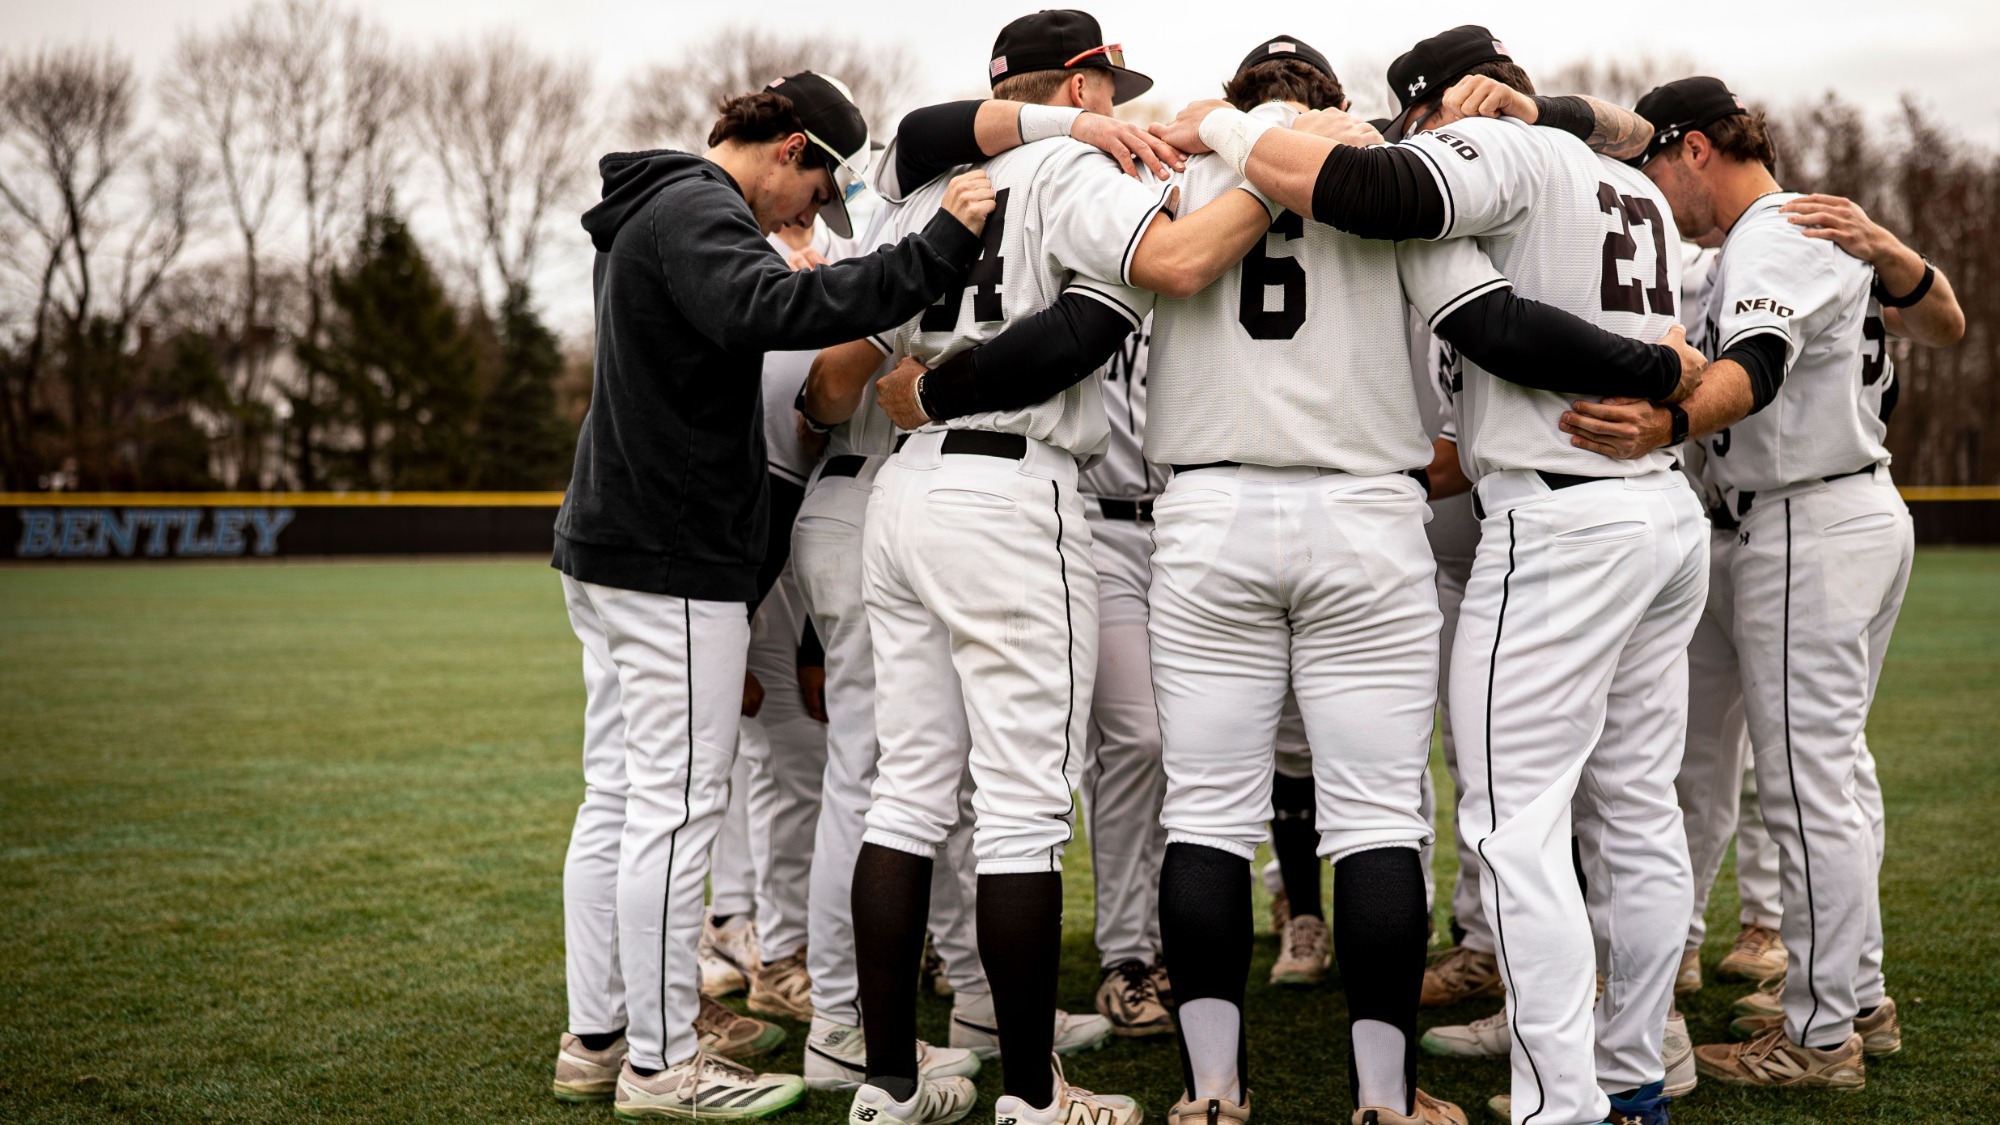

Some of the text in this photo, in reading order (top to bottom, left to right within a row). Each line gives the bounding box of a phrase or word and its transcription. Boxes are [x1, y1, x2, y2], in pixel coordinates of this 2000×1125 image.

[1239, 208, 1307, 340] 6
[1597, 181, 1675, 317] 27
[19, 508, 294, 556] BENTLEY
